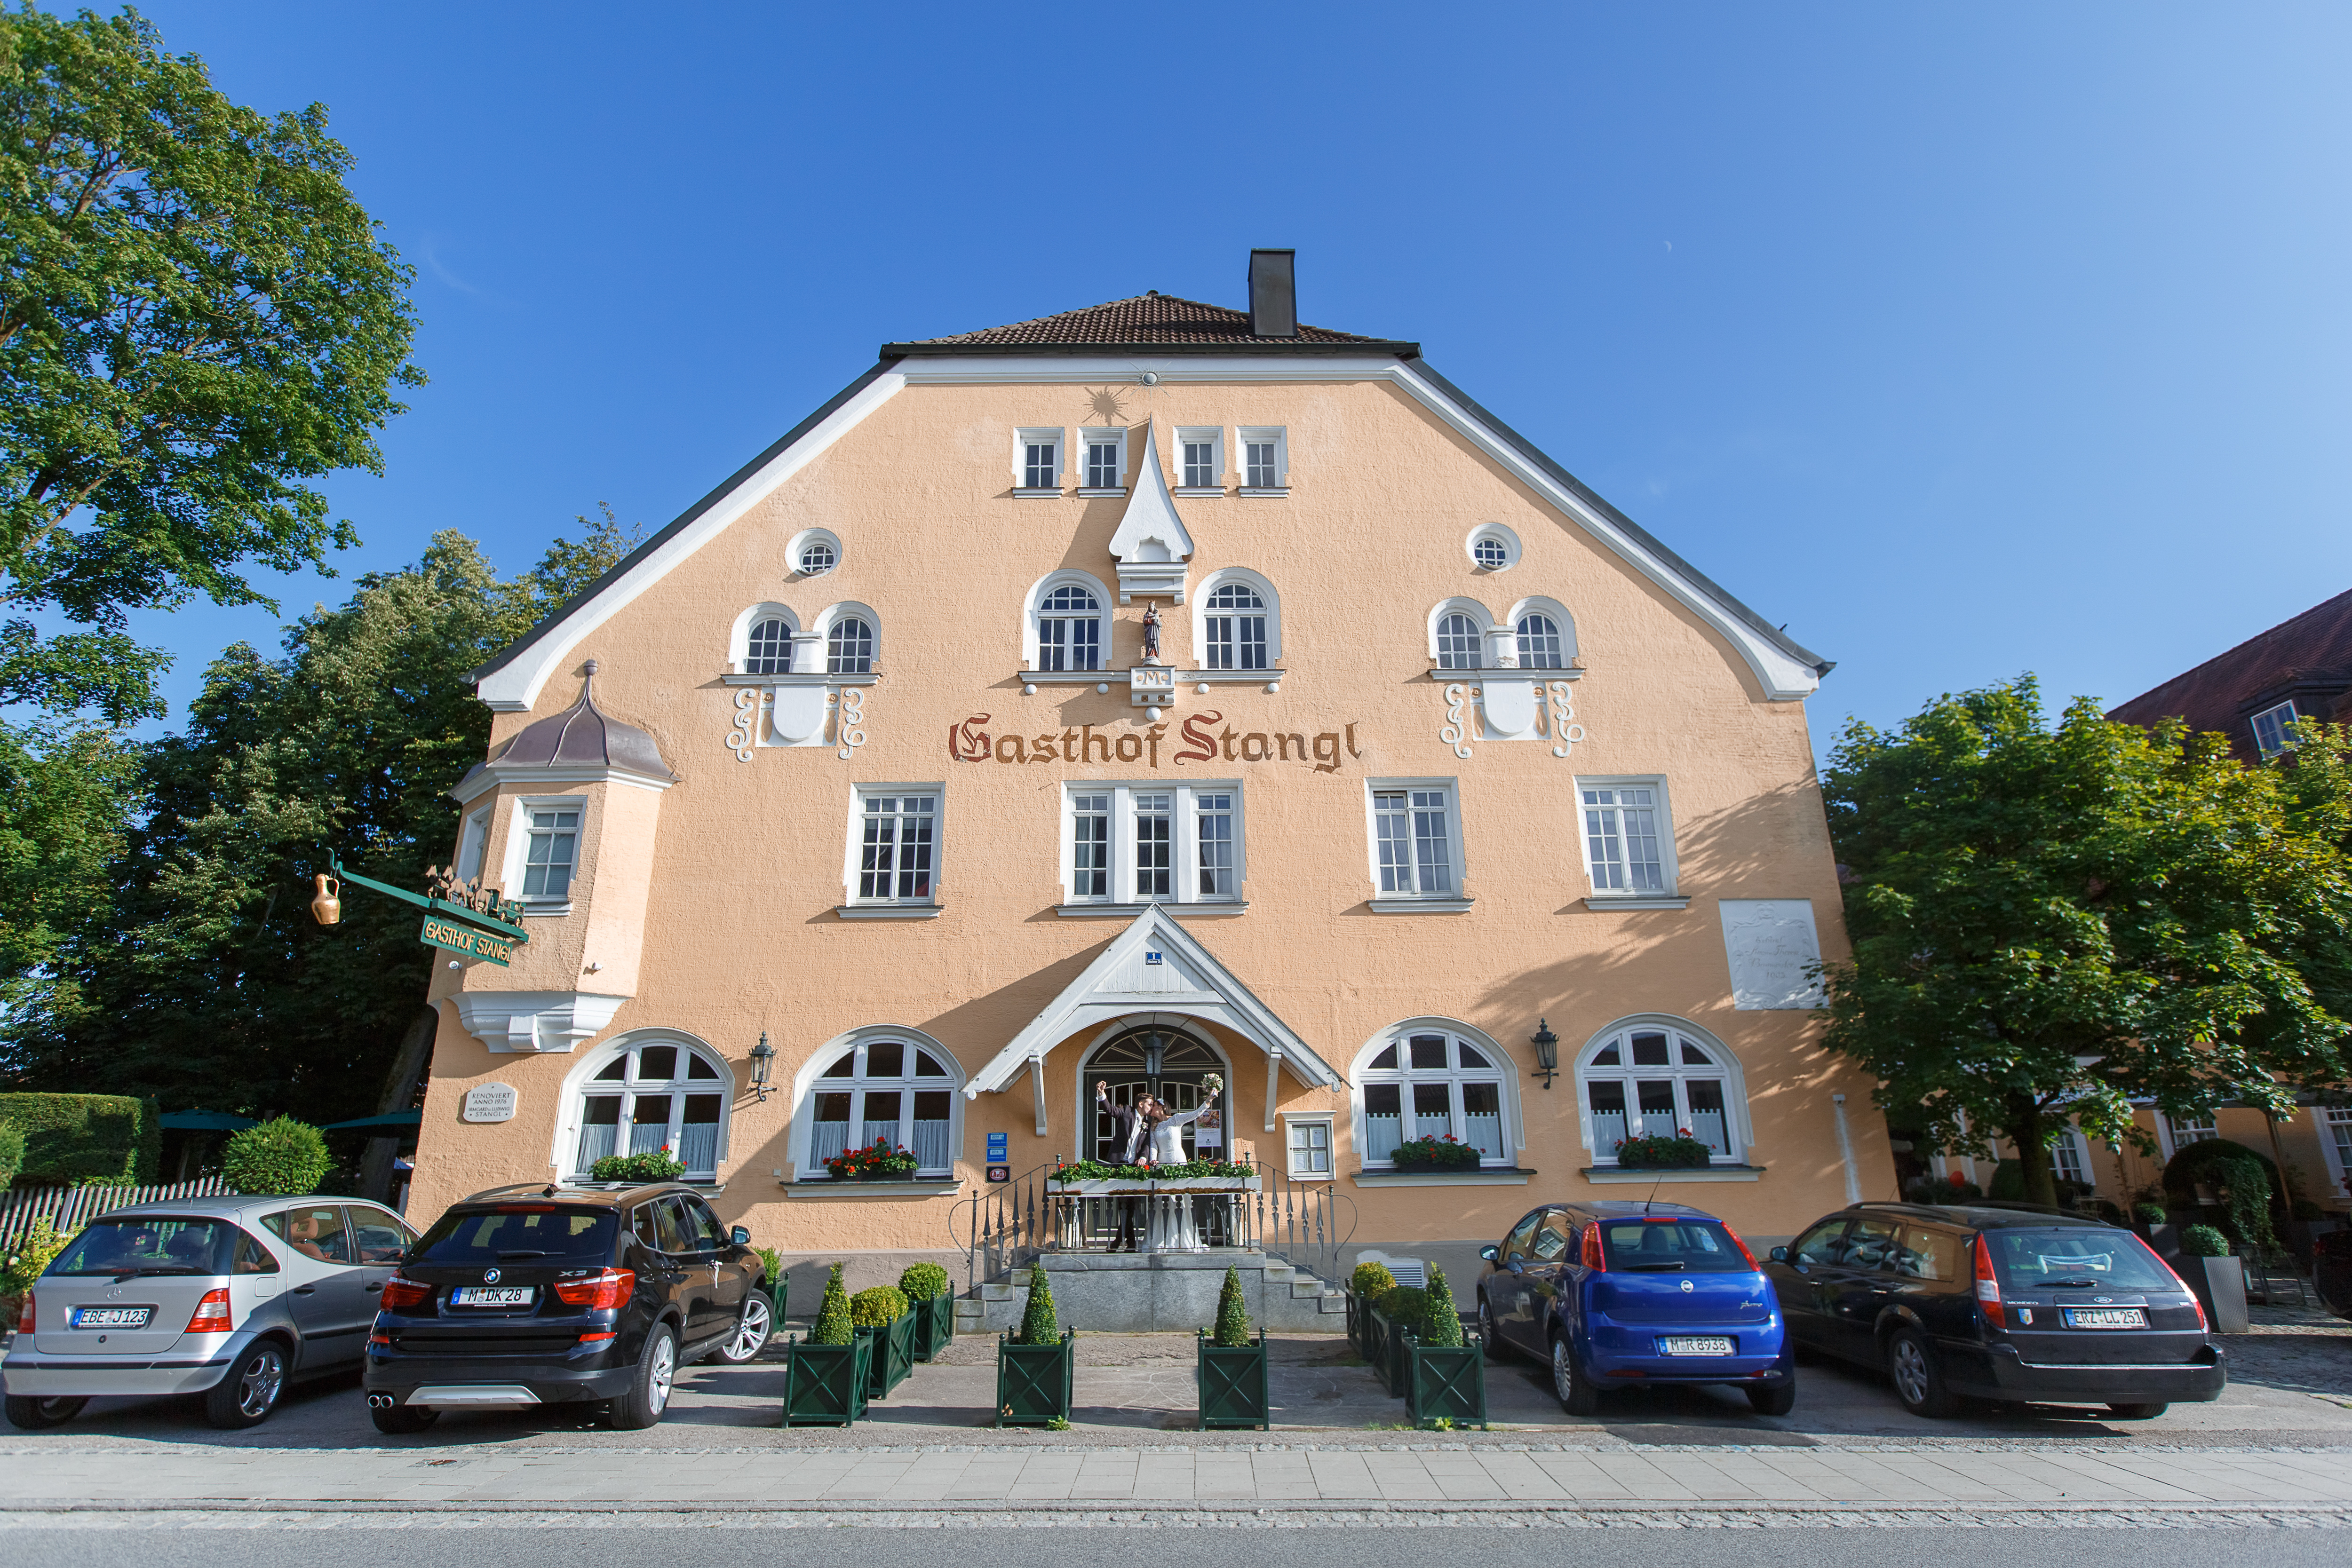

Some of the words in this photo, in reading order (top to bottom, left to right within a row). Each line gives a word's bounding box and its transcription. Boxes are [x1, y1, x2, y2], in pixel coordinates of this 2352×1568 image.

[949, 713, 1169, 768] Gasthof
[1173, 710, 1363, 774] Stangl
[425, 922, 475, 950] GASTHOF
[476, 937, 511, 962] STANGL
[1143, 1141, 1163, 1155] M
[468, 1289, 479, 1301] M
[485, 1289, 504, 1301] DK
[505, 1289, 522, 1301] 28
[80, 1310, 107, 1323] EBE
[2073, 1311, 2097, 1323] ERZ
[2103, 1311, 2119, 1324] LL
[2121, 1311, 2143, 1324] 251
[1670, 1338, 1679, 1351] M
[1686, 1338, 1695, 1351] R
[1697, 1338, 1726, 1350] 8938
